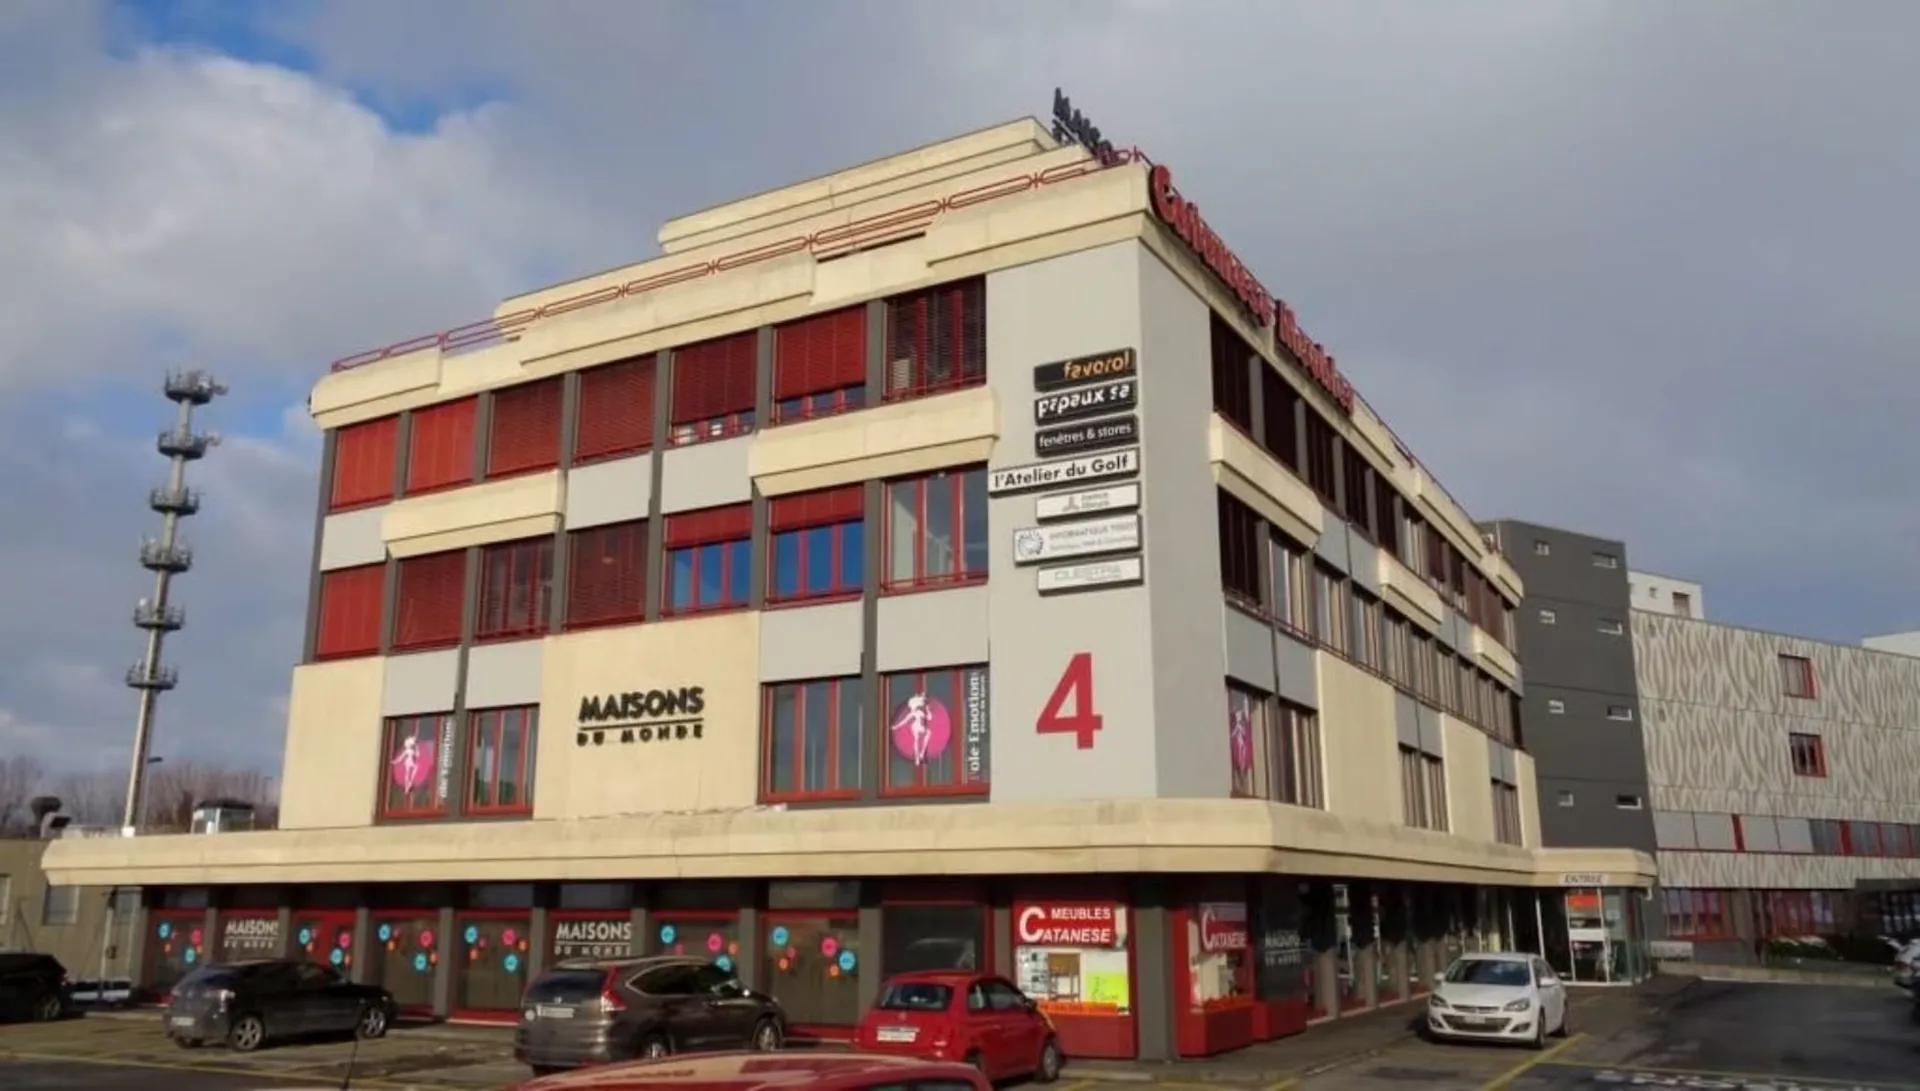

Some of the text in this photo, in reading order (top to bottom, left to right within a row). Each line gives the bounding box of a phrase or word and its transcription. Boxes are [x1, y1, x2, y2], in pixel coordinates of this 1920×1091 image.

[1063, 351, 1130, 379] favorol
[1110, 383, 1130, 400] sa
[1039, 423, 1132, 448] fenêtres & stores
[994, 453, 1131, 488] l'Atelier du Golf
[578, 686, 705, 723] MAISONS
[1036, 652, 1104, 750] 4
[576, 723, 704, 747] DU MONDE
[1051, 907, 1112, 920] MEUBLES
[555, 921, 632, 940] MAISONS
